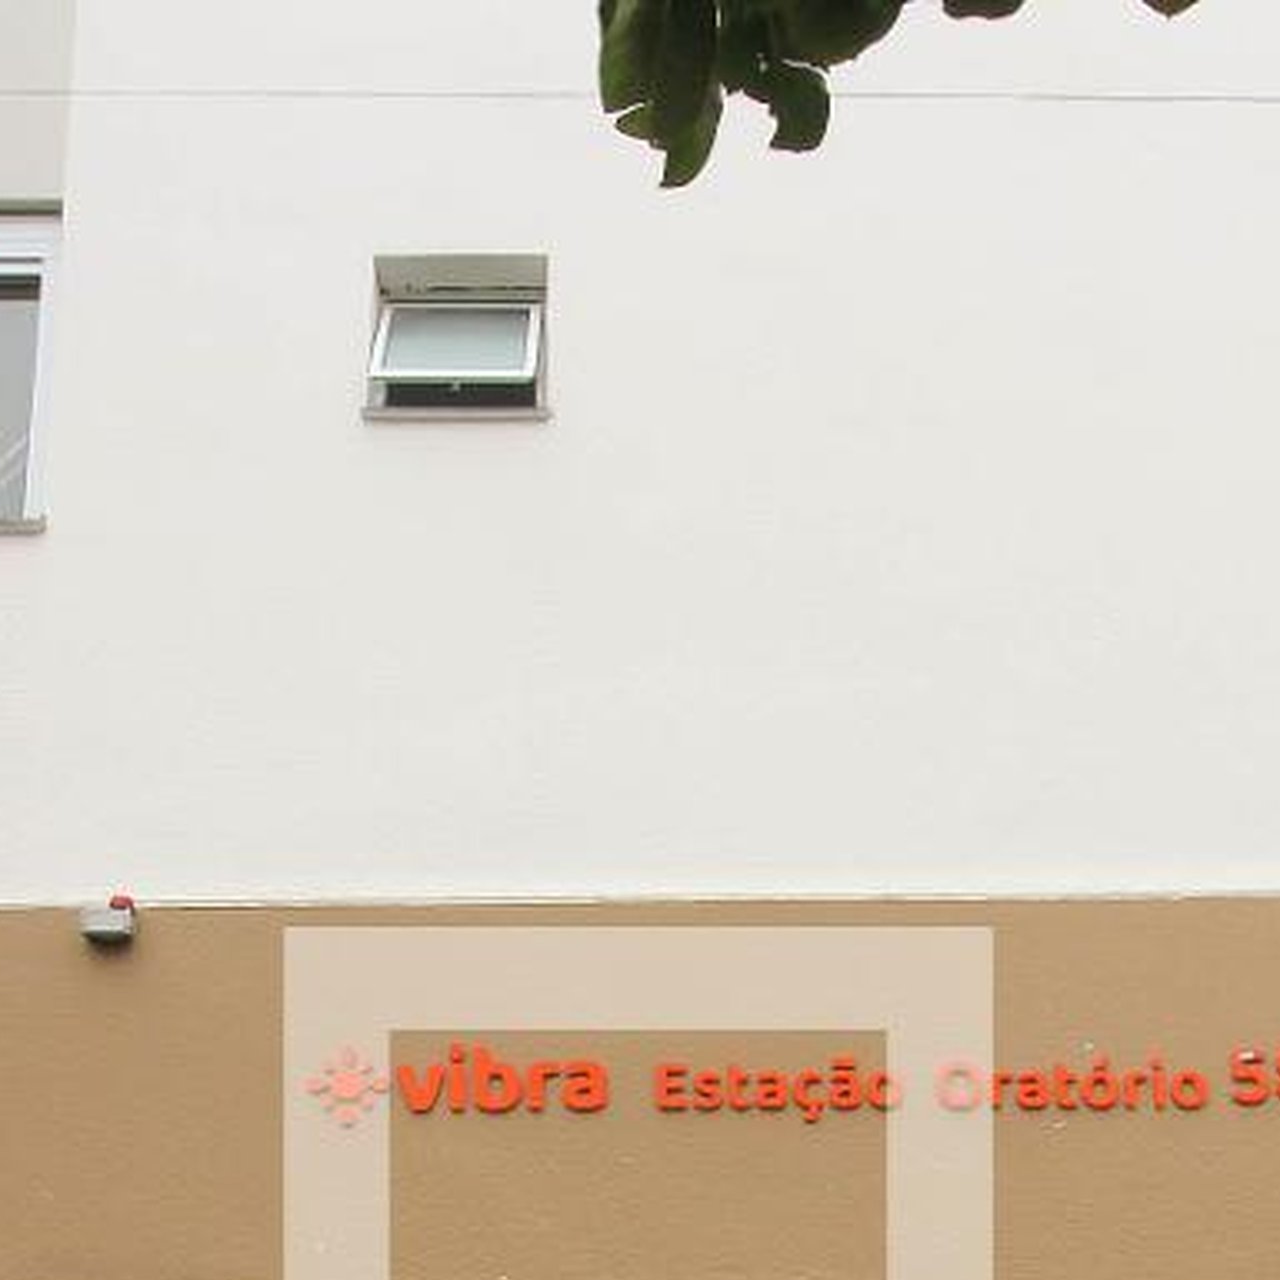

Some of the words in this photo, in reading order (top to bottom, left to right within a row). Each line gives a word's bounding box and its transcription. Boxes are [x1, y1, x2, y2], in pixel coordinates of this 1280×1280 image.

[396, 1043, 609, 1115] vibra
[653, 1052, 903, 1122] Estação
[936, 1054, 1211, 1112] Oratório
